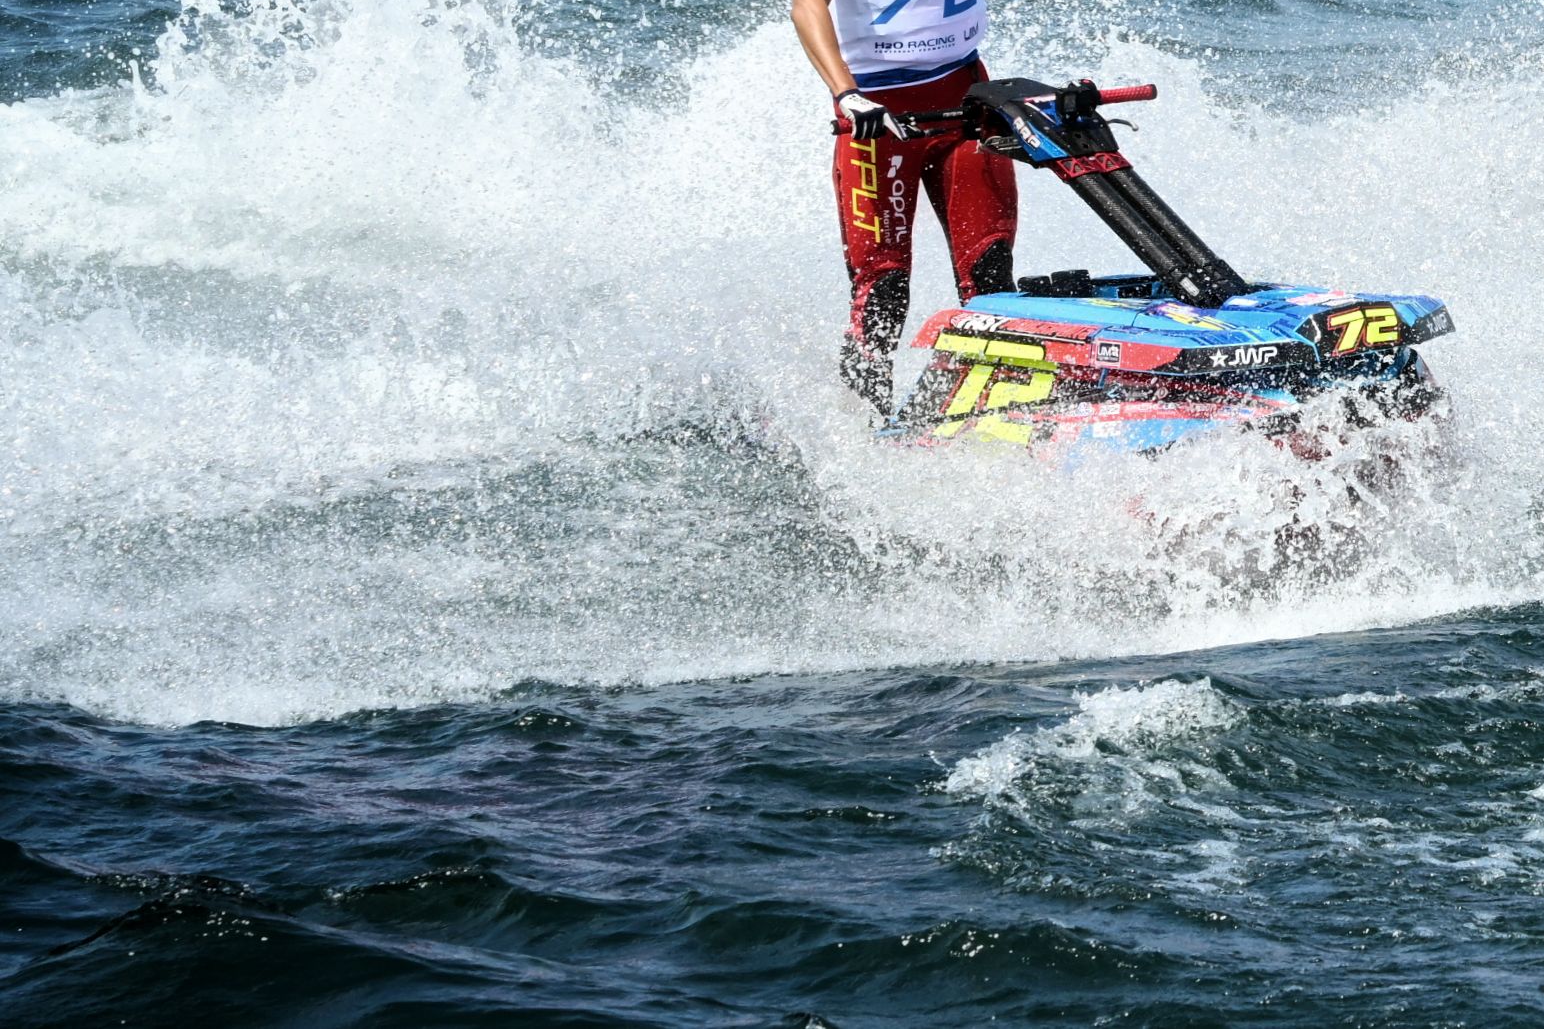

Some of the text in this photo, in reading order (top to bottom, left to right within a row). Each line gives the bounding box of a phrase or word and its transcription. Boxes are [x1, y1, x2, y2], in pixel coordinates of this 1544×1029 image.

[874, 34, 956, 50] H2O RACING
[882, 209, 893, 245] Marine
[889, 179, 908, 243] april
[1327, 307, 1400, 358] 72
[1229, 346, 1278, 365] JWP
